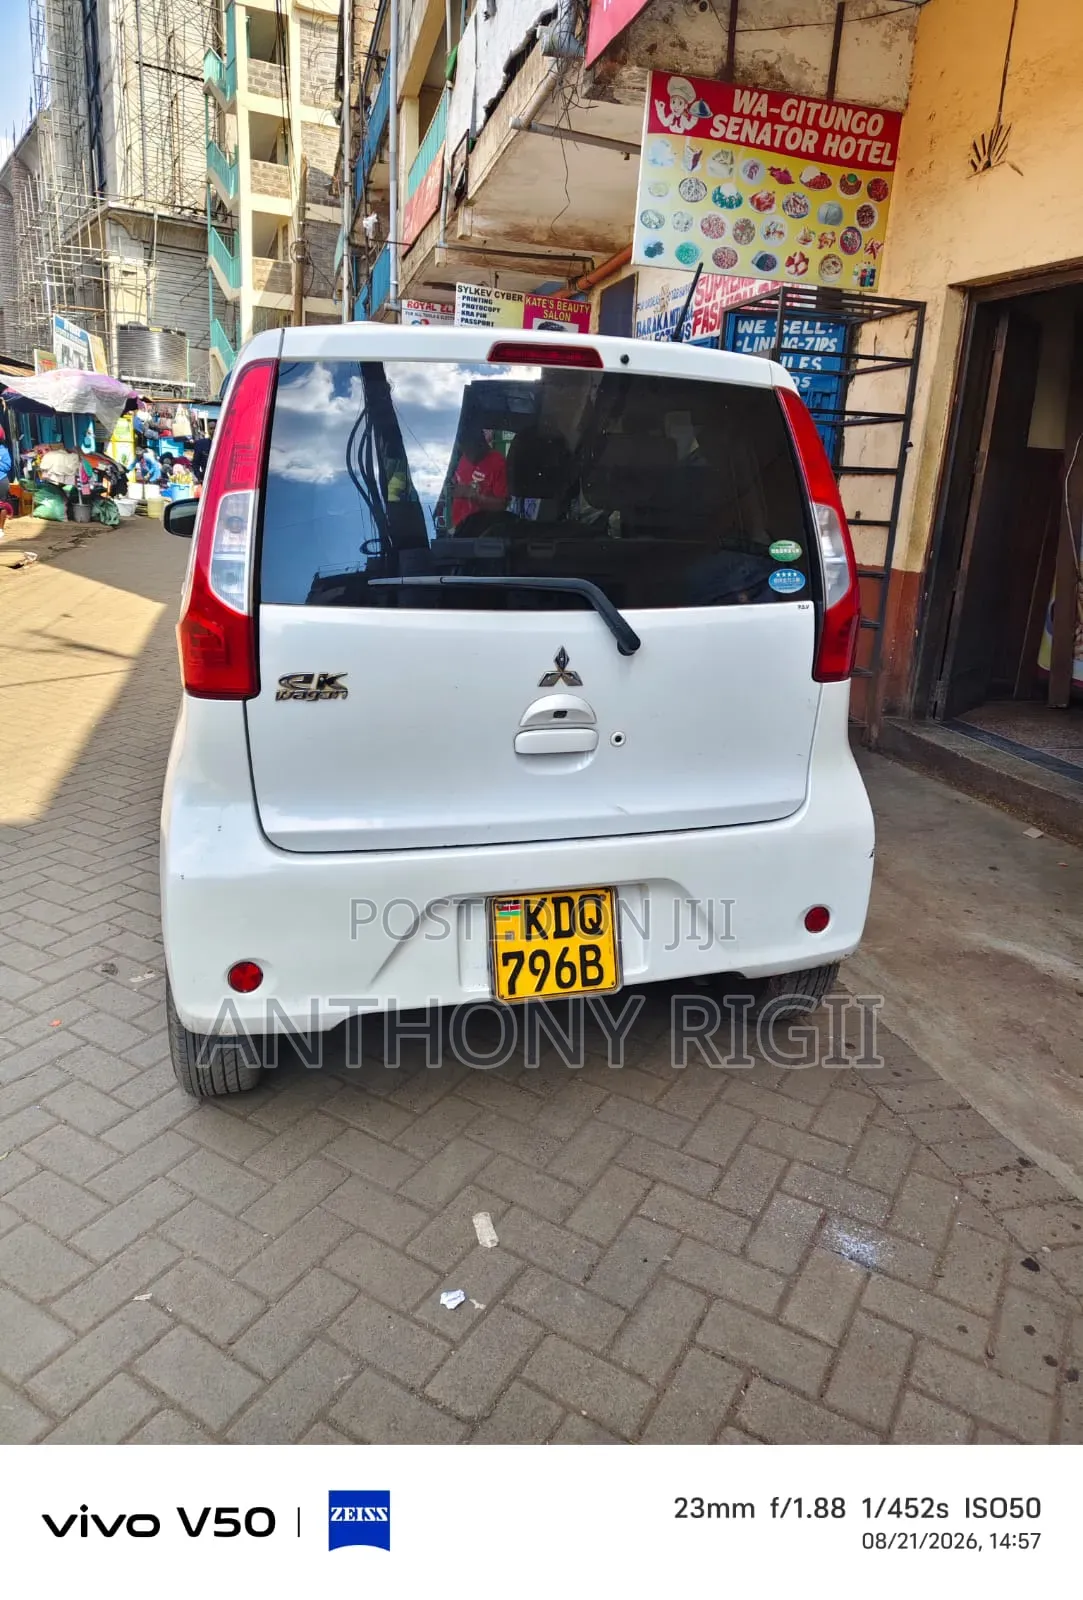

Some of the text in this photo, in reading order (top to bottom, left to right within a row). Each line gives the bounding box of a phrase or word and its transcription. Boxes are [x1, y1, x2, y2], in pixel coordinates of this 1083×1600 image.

[733, 89, 884, 137] WA-GITUNGO
[710, 114, 894, 166] SENATOR HOTEL
[462, 295, 493, 305] PRINTING
[494, 290, 523, 302] CYBER
[407, 301, 437, 311] ROYAL
[461, 303, 501, 313] PHOTOCOPY
[525, 296, 590, 314] KATE'S BEAUTY
[543, 310, 571, 322] SALON
[737, 320, 767, 334] WE
[525, 893, 606, 941] KDQ
[501, 944, 604, 995] 796B
